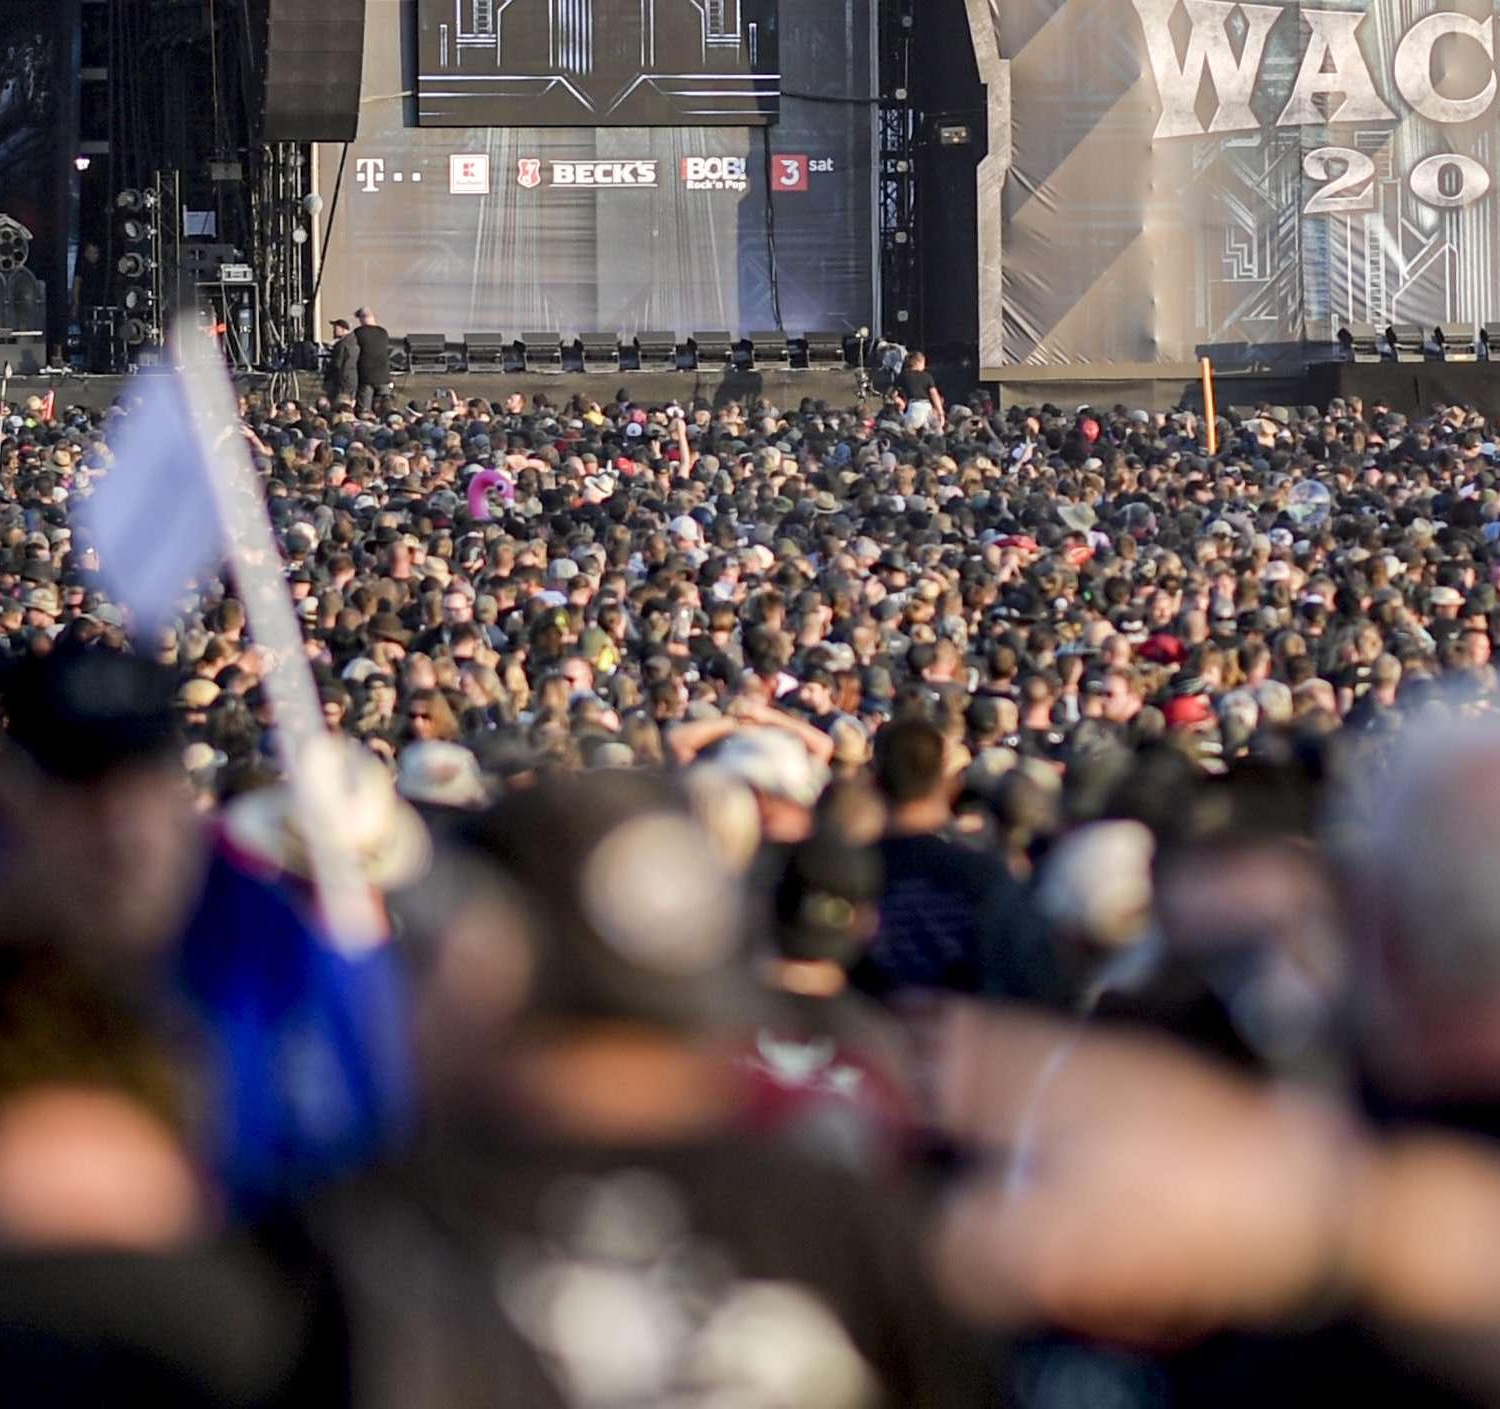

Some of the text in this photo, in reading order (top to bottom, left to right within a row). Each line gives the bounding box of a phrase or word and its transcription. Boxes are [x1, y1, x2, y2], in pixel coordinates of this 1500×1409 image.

[553, 163, 655, 184] BECK'S
[686, 157, 747, 180] BOB!
[686, 180, 747, 190] Rock'n Pop
